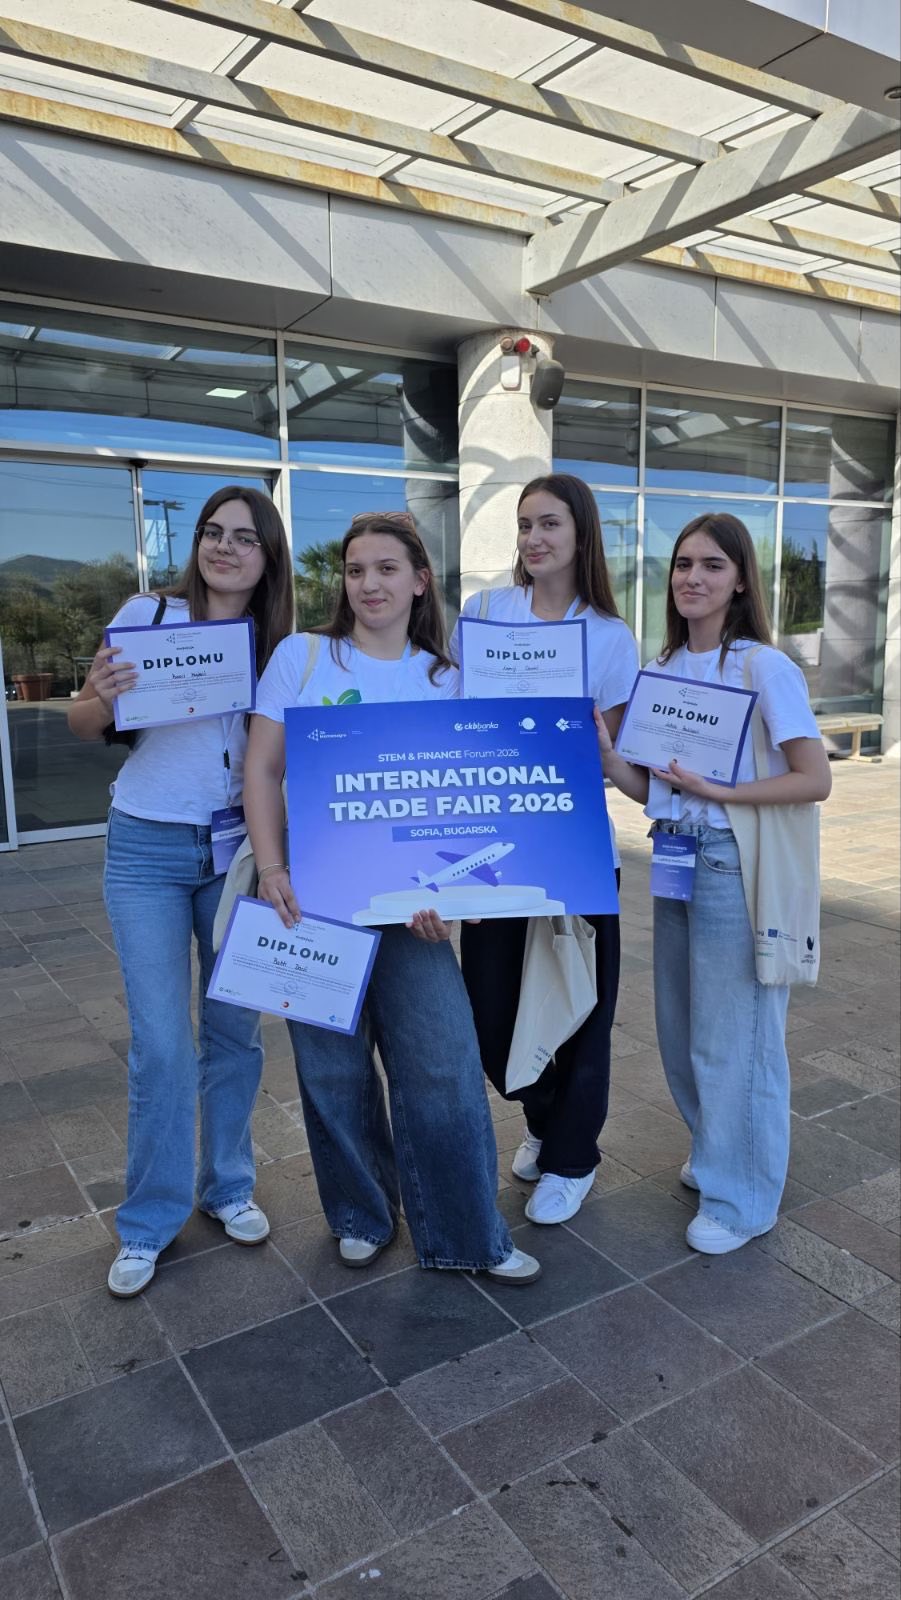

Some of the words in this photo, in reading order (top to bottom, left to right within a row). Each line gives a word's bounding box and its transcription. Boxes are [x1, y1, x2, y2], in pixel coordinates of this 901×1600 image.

[143, 652, 224, 670] DIPLOMU
[486, 649, 557, 661] DIPLOMU
[652, 703, 719, 726] DIPLOMU
[378, 753, 406, 763] STEM
[408, 752, 415, 761] &
[417, 750, 462, 761] FINANCE
[464, 749, 495, 759] Forum
[497, 748, 519, 758] 2026
[335, 765, 565, 793] INTERNATIONAL
[329, 797, 428, 822] TRADE
[436, 795, 501, 817] FAIR
[508, 792, 574, 814] 2026
[410, 828, 442, 838] SOFIA,
[444, 825, 497, 836] BUGARSKA
[257, 935, 339, 967] DIPLOMU
